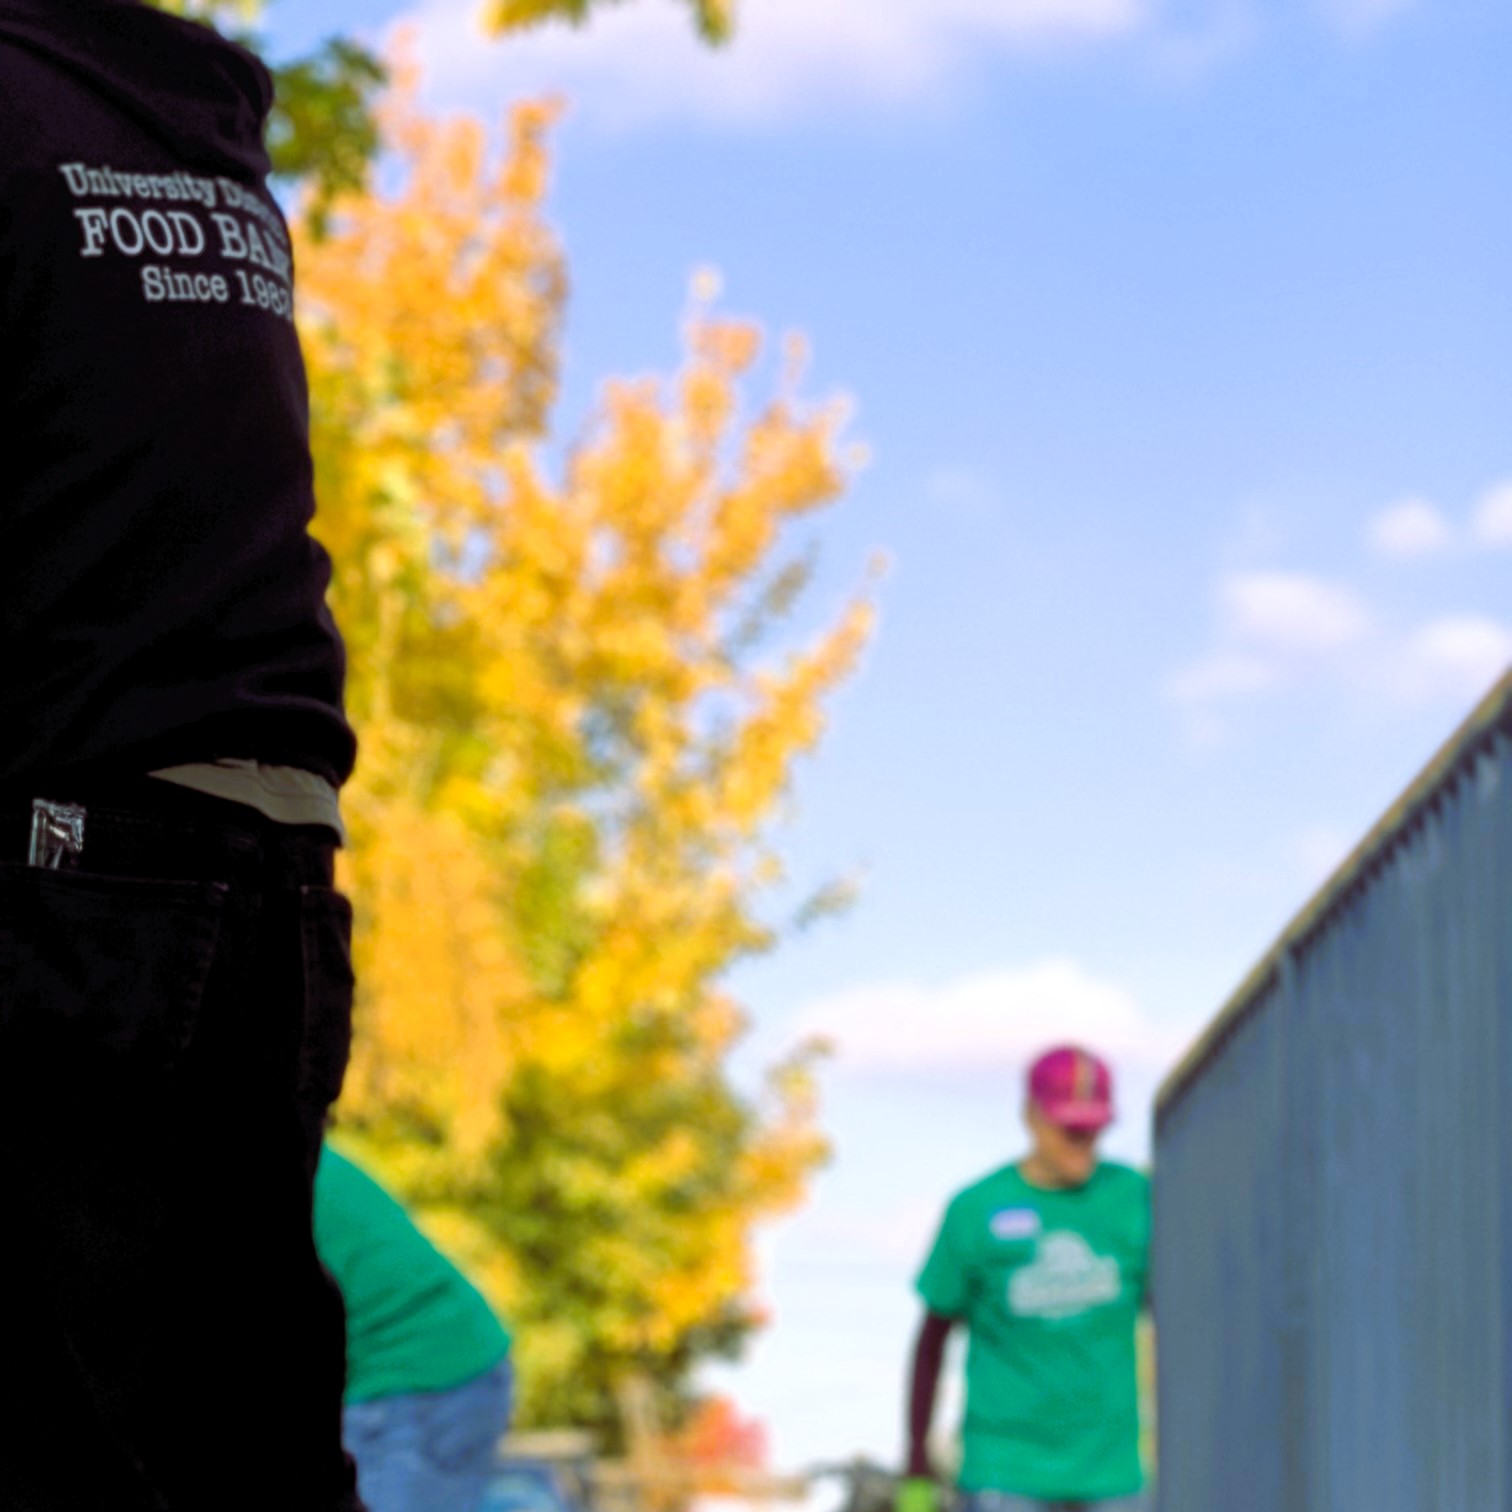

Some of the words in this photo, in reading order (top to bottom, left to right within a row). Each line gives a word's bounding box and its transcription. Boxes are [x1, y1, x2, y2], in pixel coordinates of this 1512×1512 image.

[59, 162, 215, 206] University
[74, 209, 205, 256] FOOD
[141, 264, 229, 301] Since
